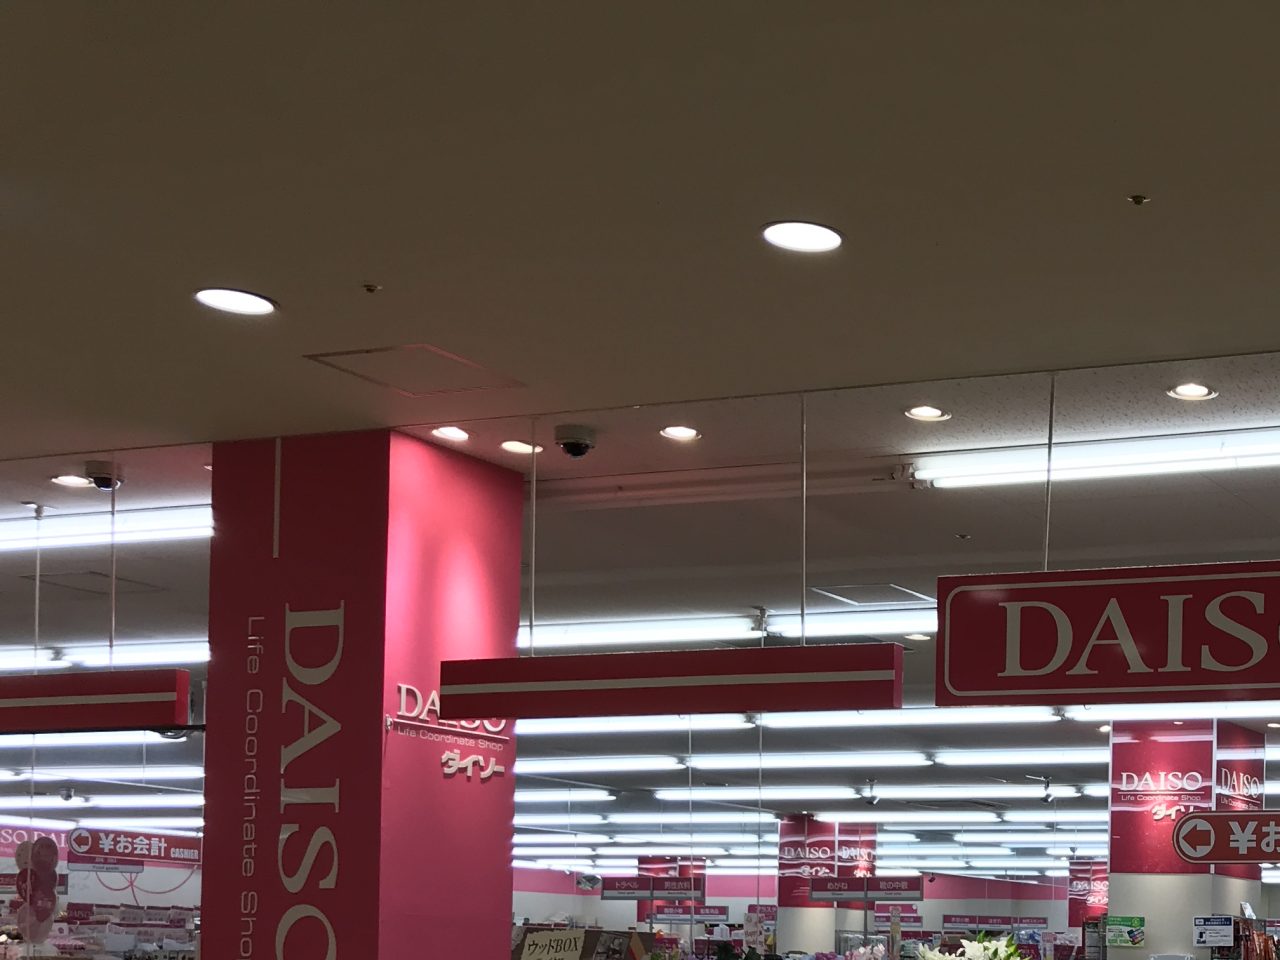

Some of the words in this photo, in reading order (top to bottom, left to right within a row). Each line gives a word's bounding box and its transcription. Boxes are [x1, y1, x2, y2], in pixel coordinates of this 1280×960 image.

[247, 615, 265, 674] Life
[398, 727, 416, 737] Life
[420, 730, 475, 747] Coordinate
[478, 738, 503, 752] Shop
[441, 749, 505, 779] ダイソー
[242, 689, 263, 878] Coordinate
[1120, 771, 1203, 791] DAISO
[1221, 767, 1260, 798] DAISO
[99, 833, 168, 857] ¥お会計
[784, 847, 830, 858] DAISO
[528, 937, 580, 956] ウッドBOX
